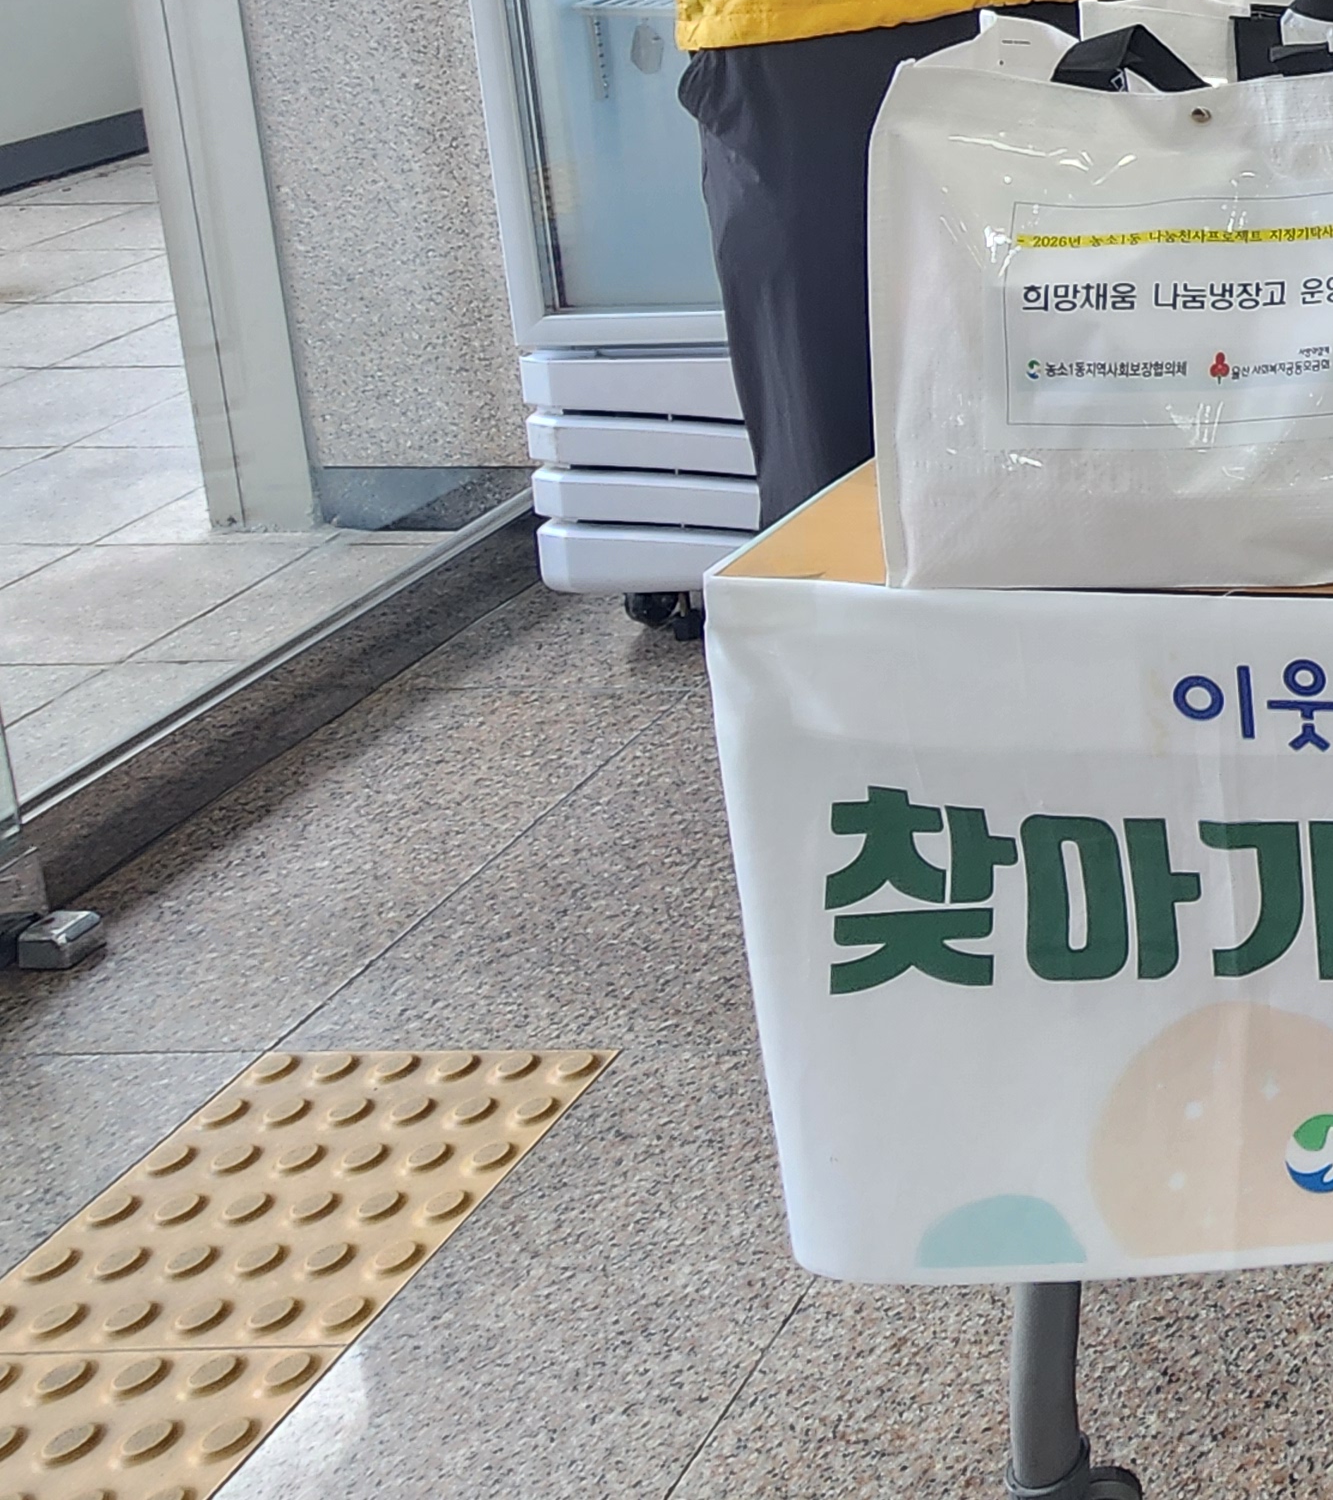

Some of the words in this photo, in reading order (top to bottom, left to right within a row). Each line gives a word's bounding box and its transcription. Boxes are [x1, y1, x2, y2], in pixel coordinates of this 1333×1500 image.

[1032, 235, 1081, 248] 2026년
[1021, 281, 1138, 312] 희망채움
[1153, 281, 1287, 311] 나눔냉장고
[1045, 360, 1188, 379] 농소1동지역사회보장협의체
